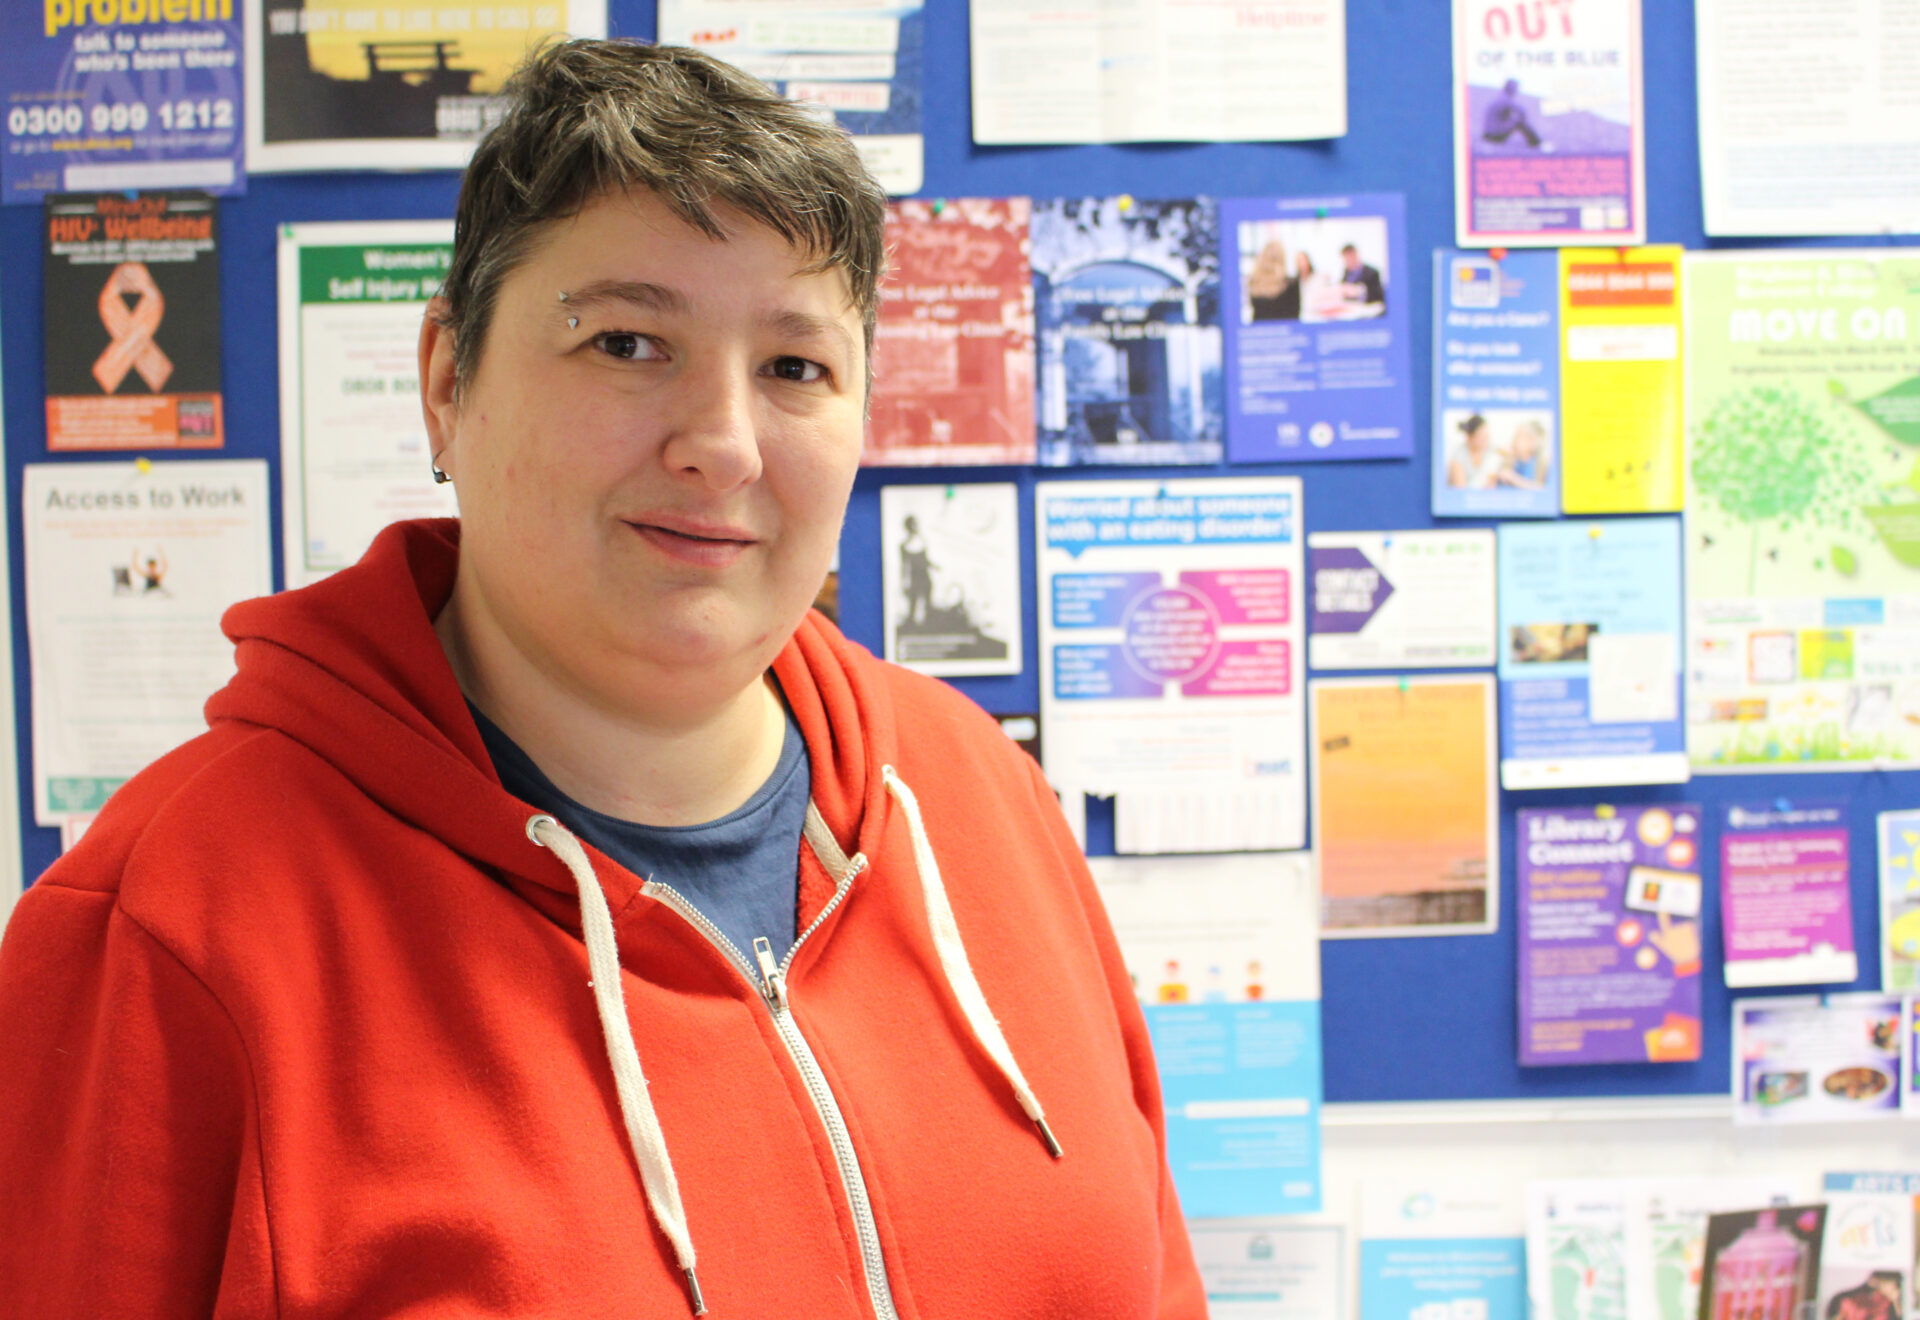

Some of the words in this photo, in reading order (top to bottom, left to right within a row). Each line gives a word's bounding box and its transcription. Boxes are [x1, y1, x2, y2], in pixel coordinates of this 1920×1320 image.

[44, 0, 232, 37] problem
[114, 32, 135, 51] to
[139, 30, 226, 50] someone
[132, 52, 180, 70] been
[1516, 50, 1554, 66] THE
[1565, 48, 1619, 66] BLUE
[9, 107, 83, 135] 0300
[91, 103, 148, 132] 999
[159, 101, 233, 130] 1212
[906, 284, 948, 302] Legal
[1730, 308, 1839, 342] MOVE
[1851, 307, 1907, 341] ON
[46, 487, 139, 511] Access
[149, 486, 173, 509] to
[181, 483, 246, 508] Work
[1129, 519, 1196, 543] eating
[1529, 815, 1627, 843] Library
[1528, 840, 1634, 866] Connect
